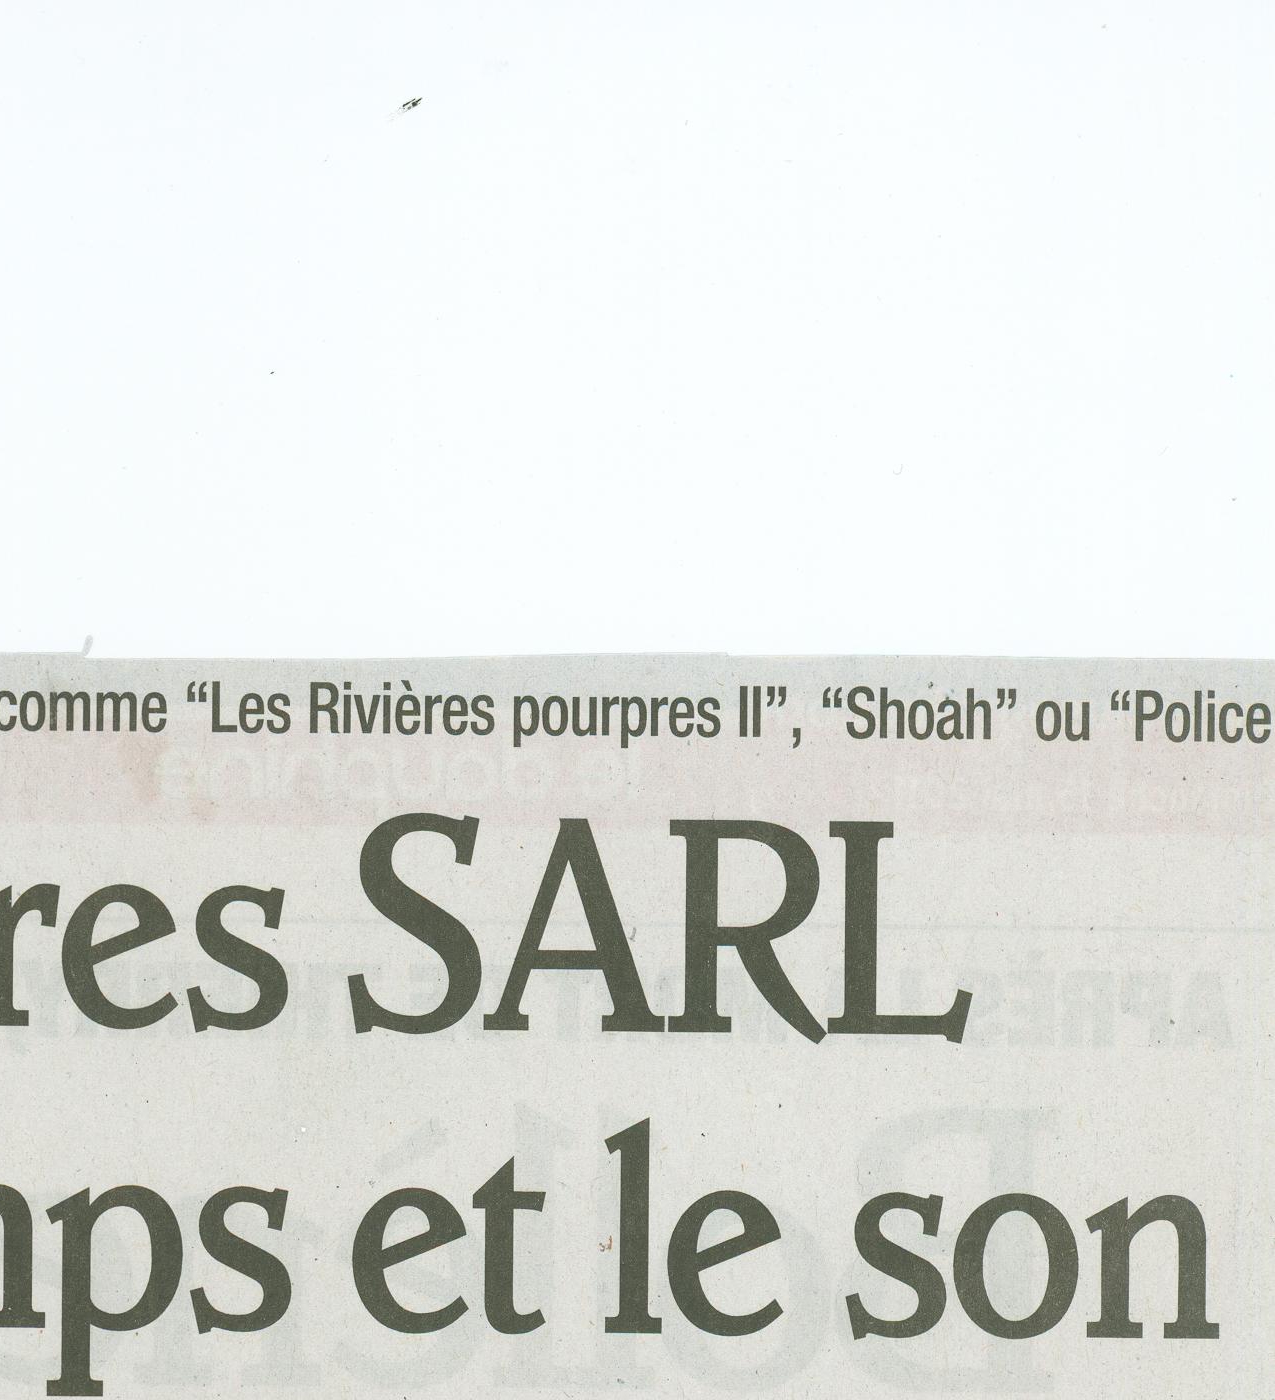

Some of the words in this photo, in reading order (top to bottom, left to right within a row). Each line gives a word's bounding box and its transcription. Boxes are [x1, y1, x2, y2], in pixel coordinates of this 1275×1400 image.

[309, 679, 495, 736] Rivières
[513, 695, 721, 749] pourpres
[739, 685, 801, 749] II”,
[1035, 700, 1090, 742] ou
[347, 812, 973, 1044] SARL
[351, 1157, 546, 1335] et
[604, 1118, 784, 1337] le
[845, 1192, 1220, 1340] son
